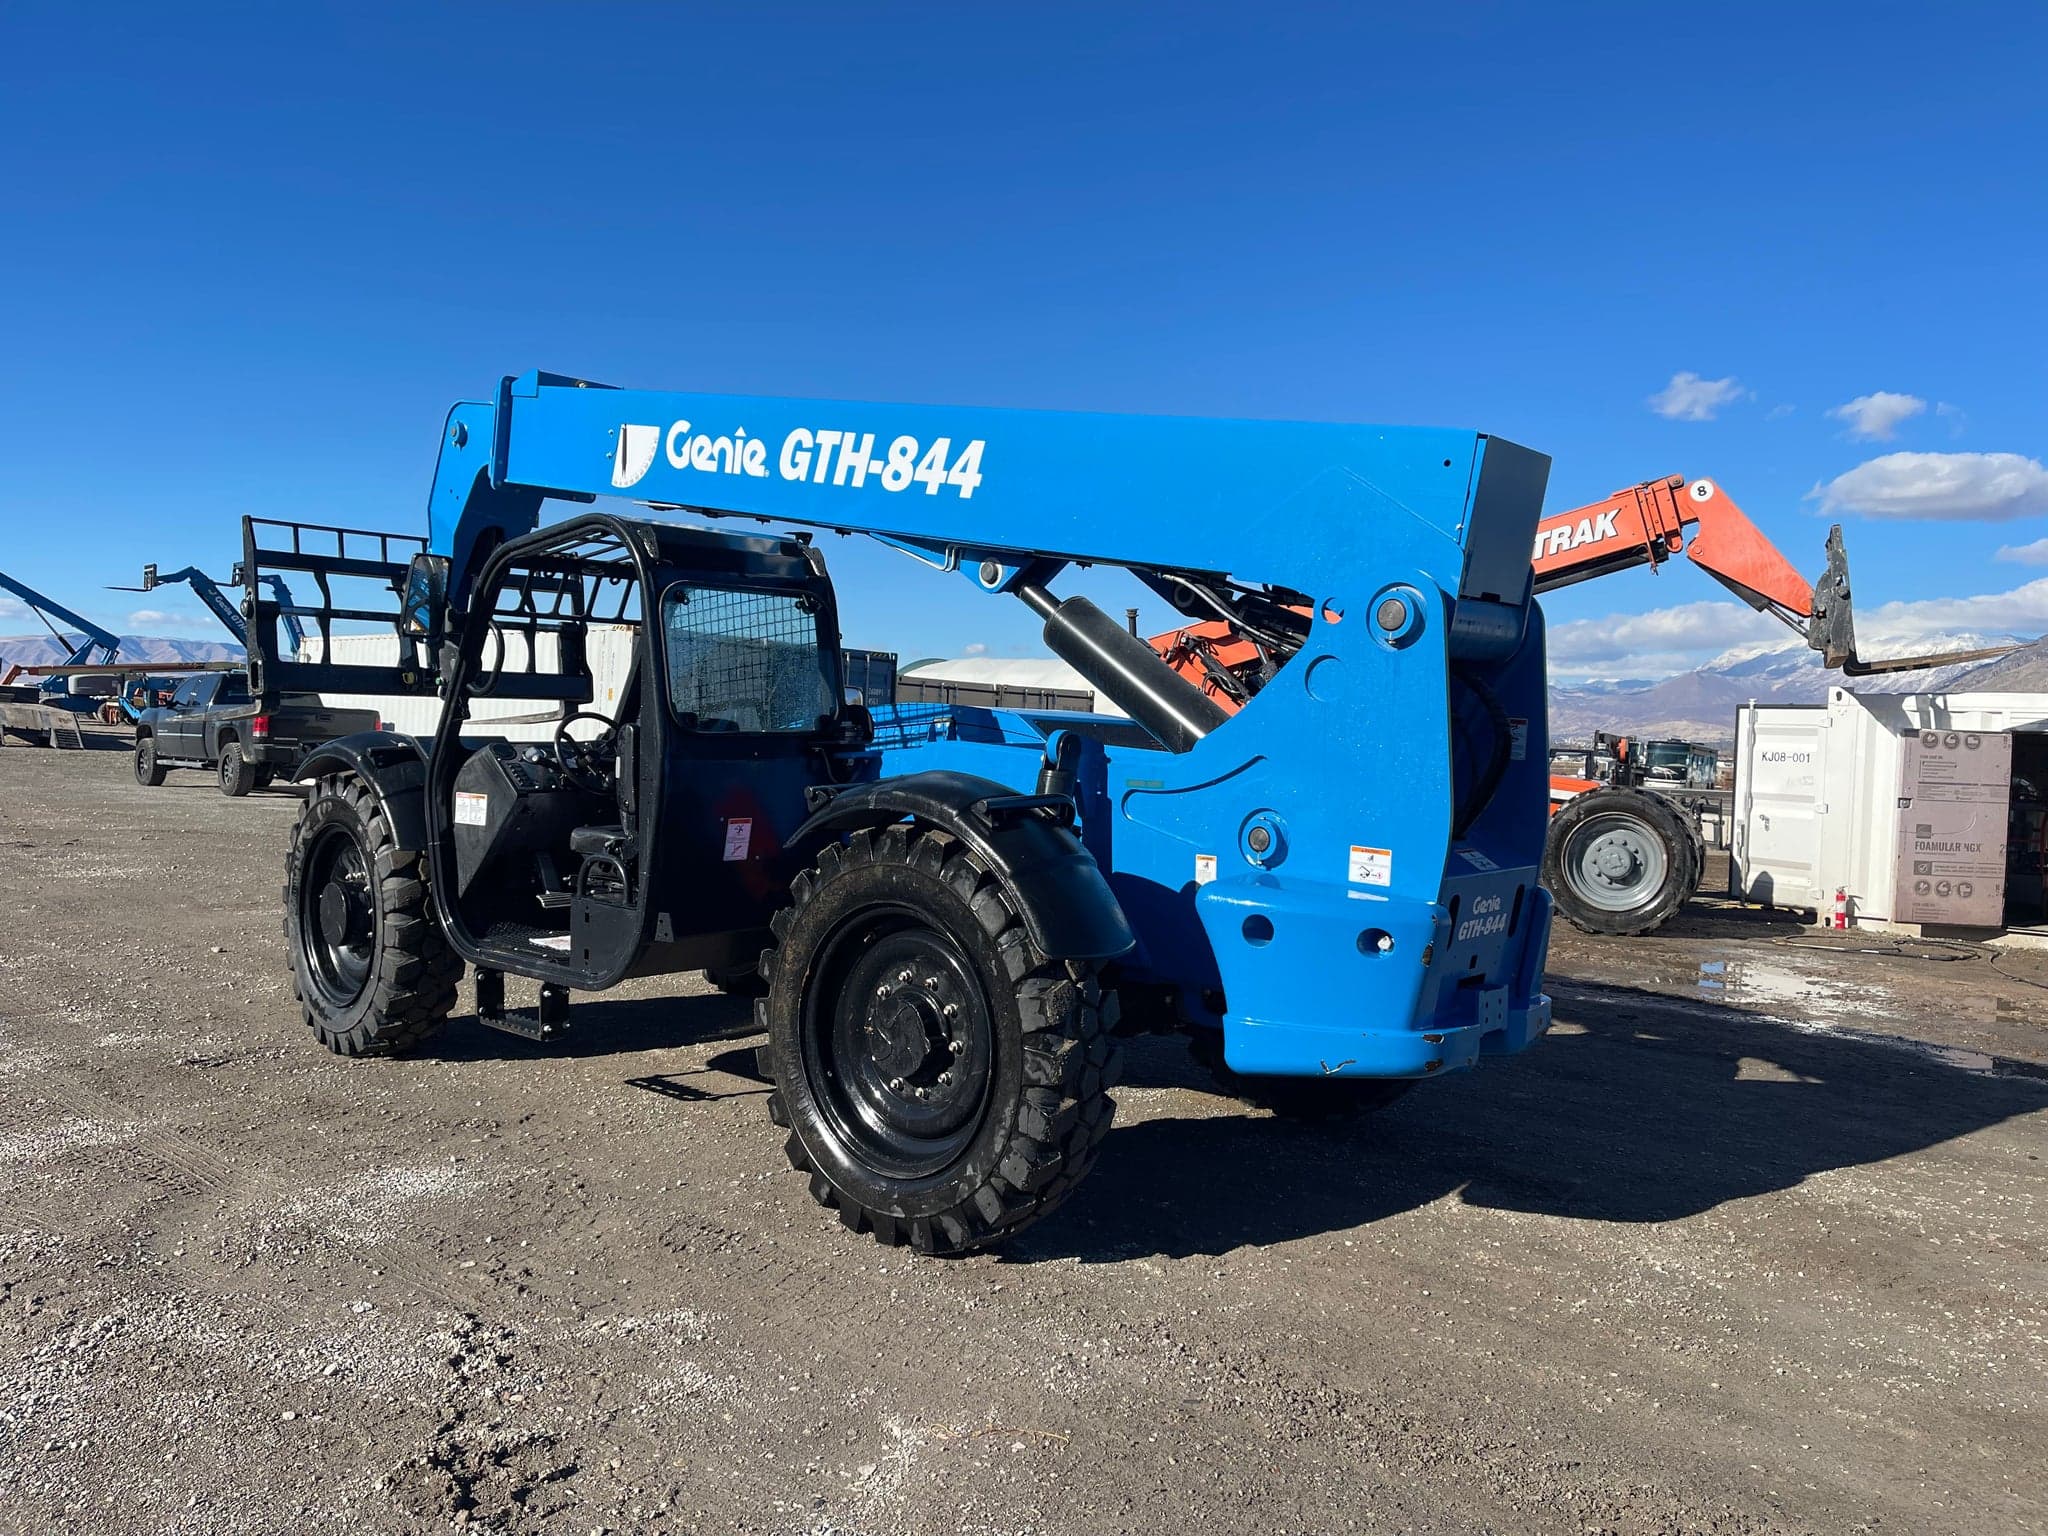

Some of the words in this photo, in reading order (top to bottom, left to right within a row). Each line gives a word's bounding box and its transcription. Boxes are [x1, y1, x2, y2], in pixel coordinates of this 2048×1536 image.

[666, 420, 768, 477] Genie
[779, 428, 986, 499] GTH-844
[1697, 486, 1707, 497] 8
[1533, 508, 1621, 560] TRAK
[1761, 751, 1810, 763] KJ08-001
[1914, 841, 1961, 853] FOAMULAR
[1473, 895, 1501, 914] Genie
[1458, 913, 1507, 941] GTH-844
